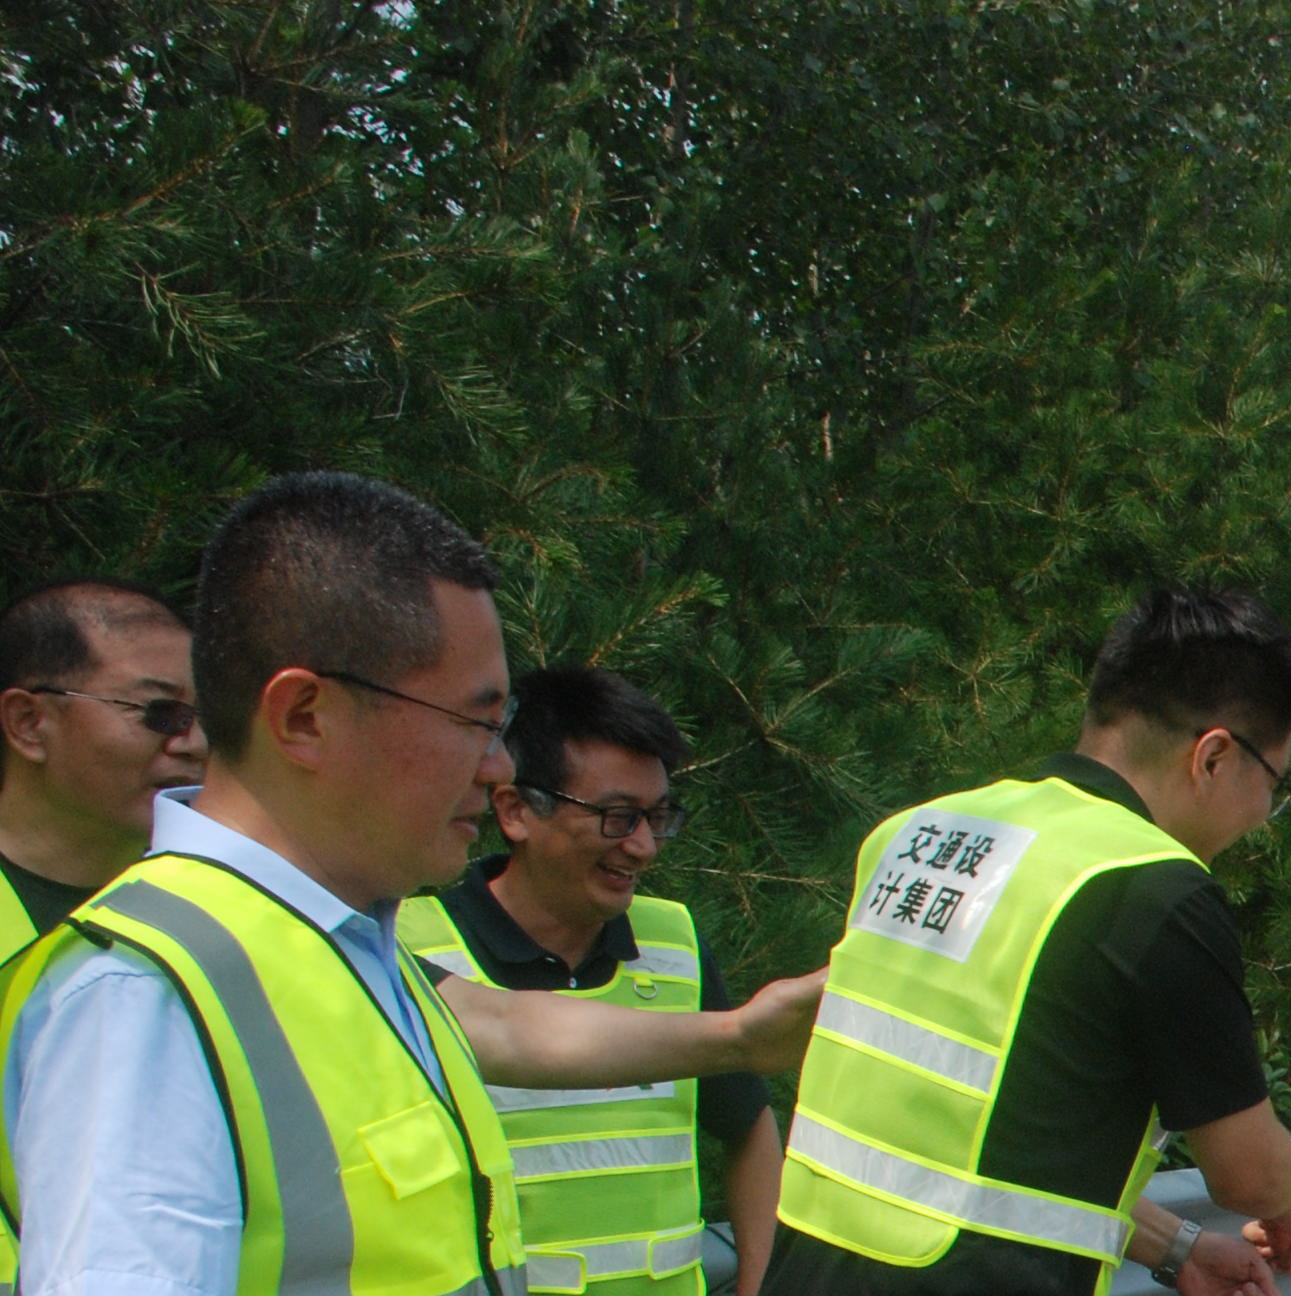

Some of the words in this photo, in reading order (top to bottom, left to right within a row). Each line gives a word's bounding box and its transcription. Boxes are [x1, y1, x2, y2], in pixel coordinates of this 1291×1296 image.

[897, 824, 997, 879] 交通设
[869, 871, 967, 935] 计集团
